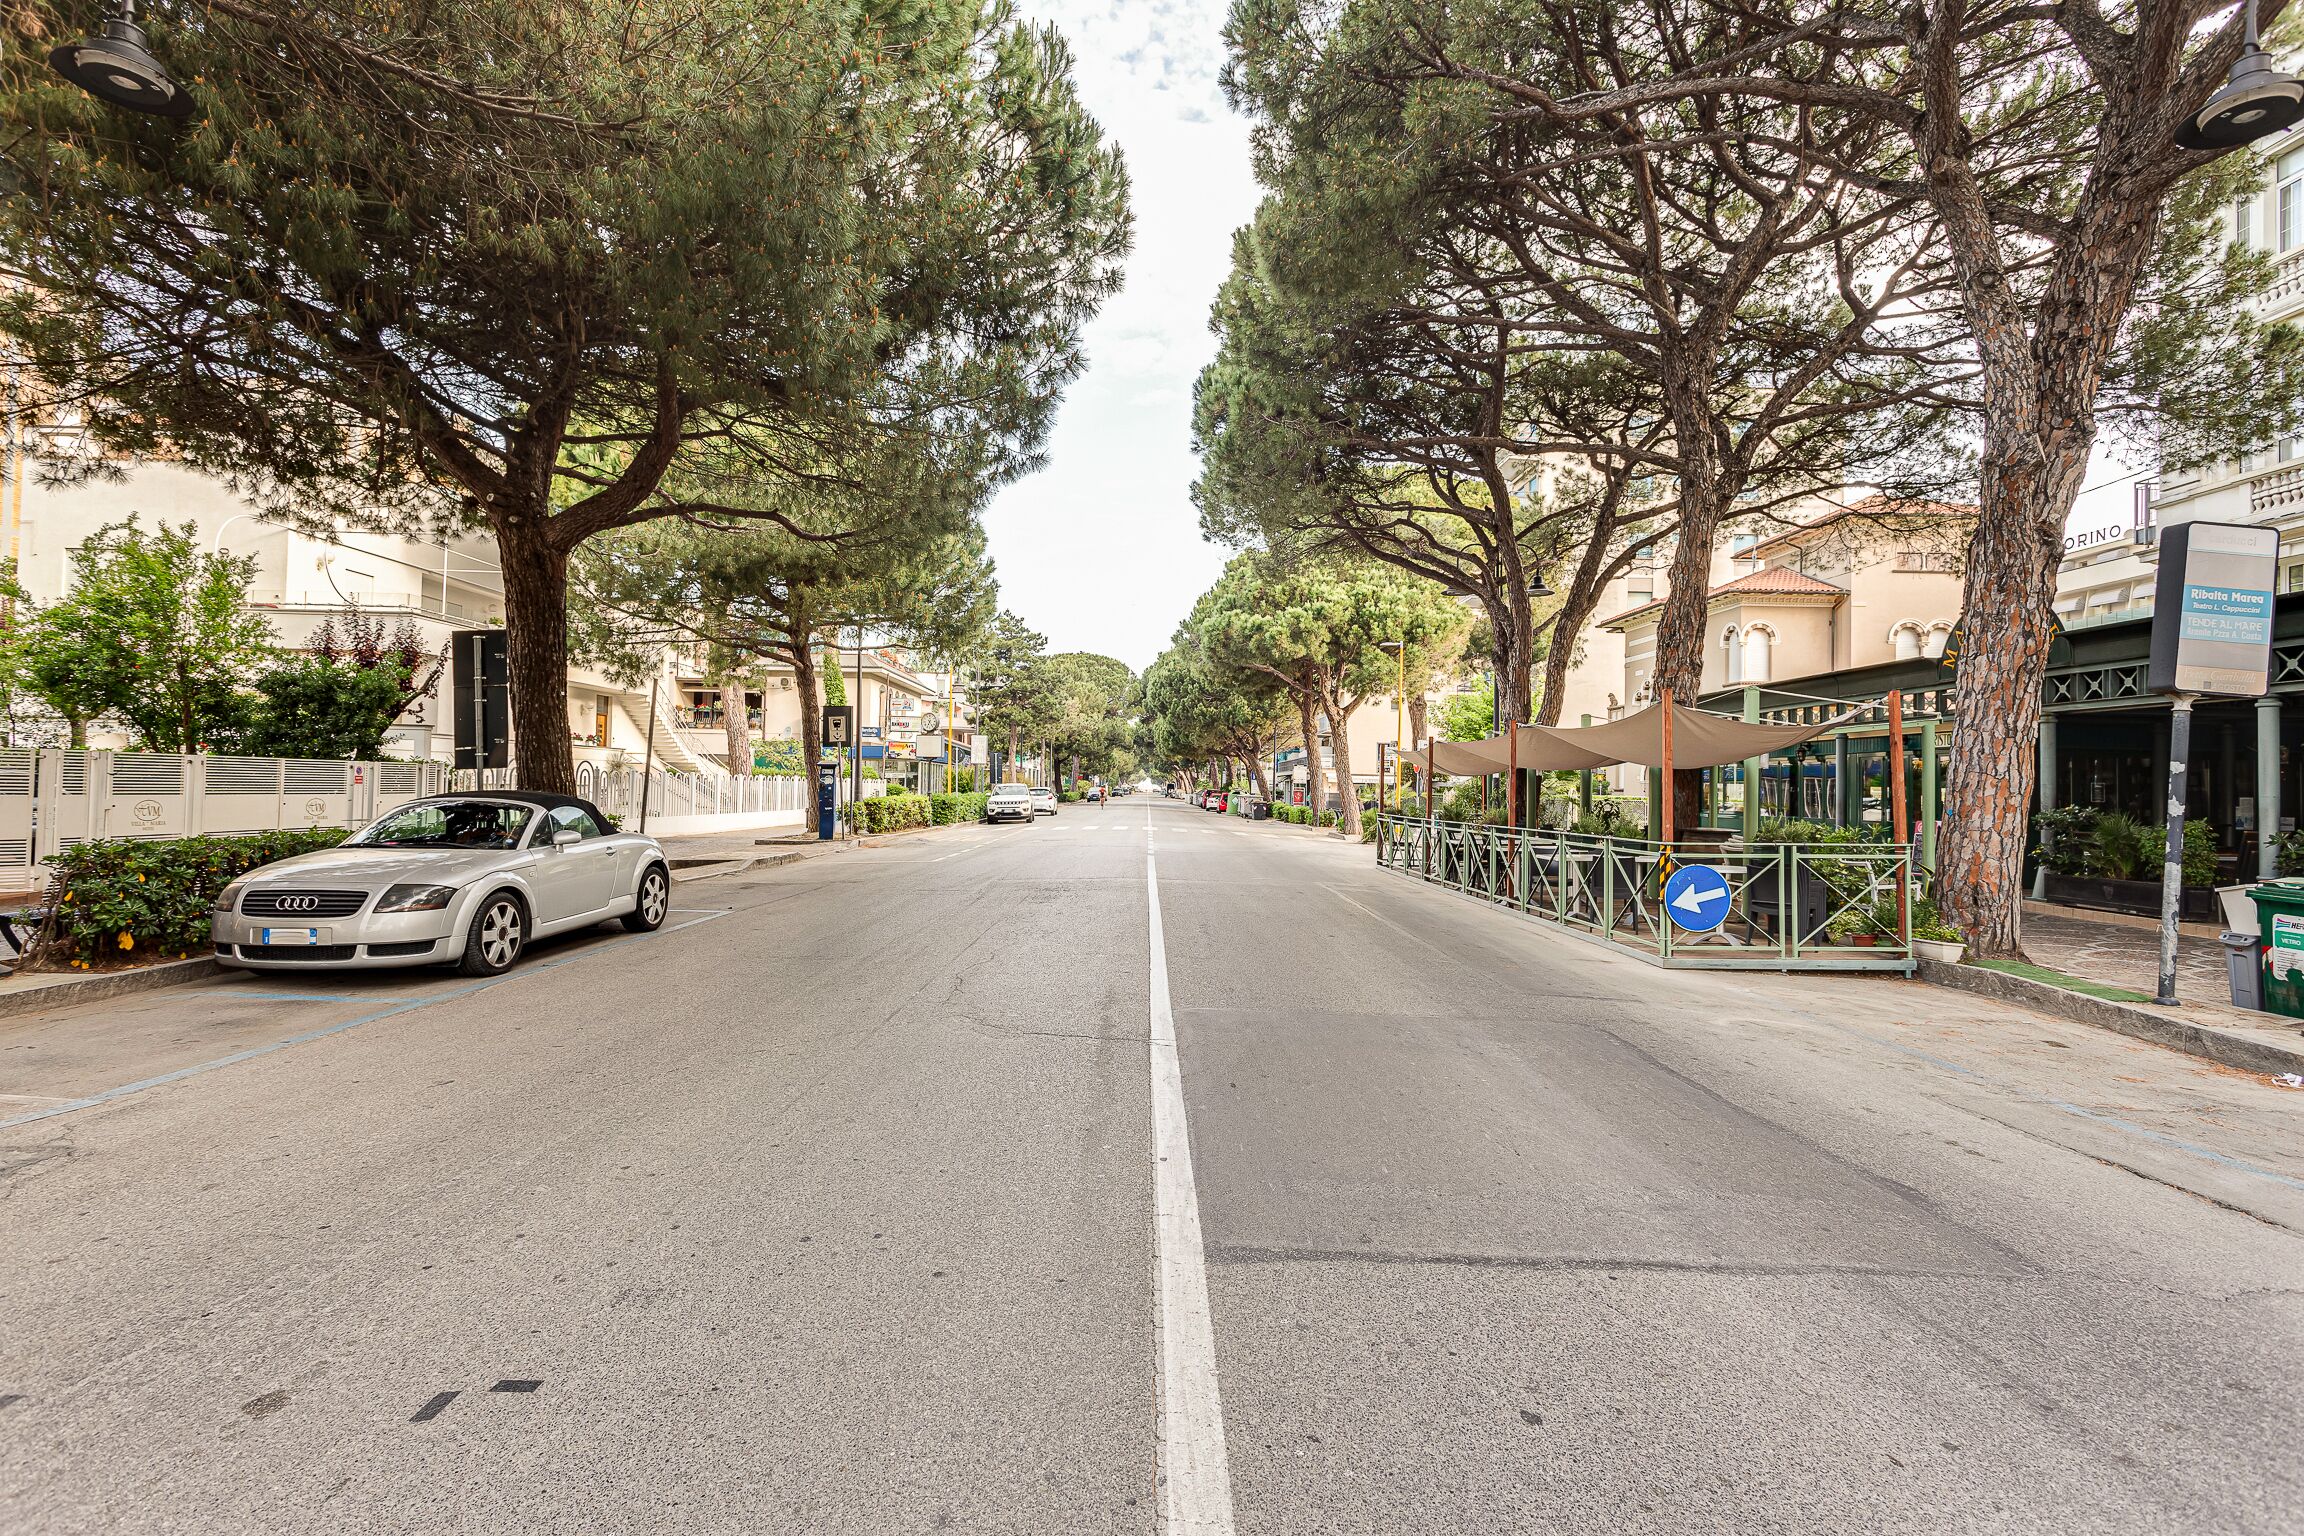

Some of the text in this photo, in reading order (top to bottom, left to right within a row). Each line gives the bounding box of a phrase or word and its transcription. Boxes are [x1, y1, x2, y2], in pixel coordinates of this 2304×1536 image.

[2064, 525, 2121, 550] ORINO
[2191, 588, 2264, 604] Ribalta Marea
[2213, 603, 2220, 611] L.
[2221, 604, 2261, 614] Cappuccini
[2187, 617, 2263, 632] TENDE AL MARE
